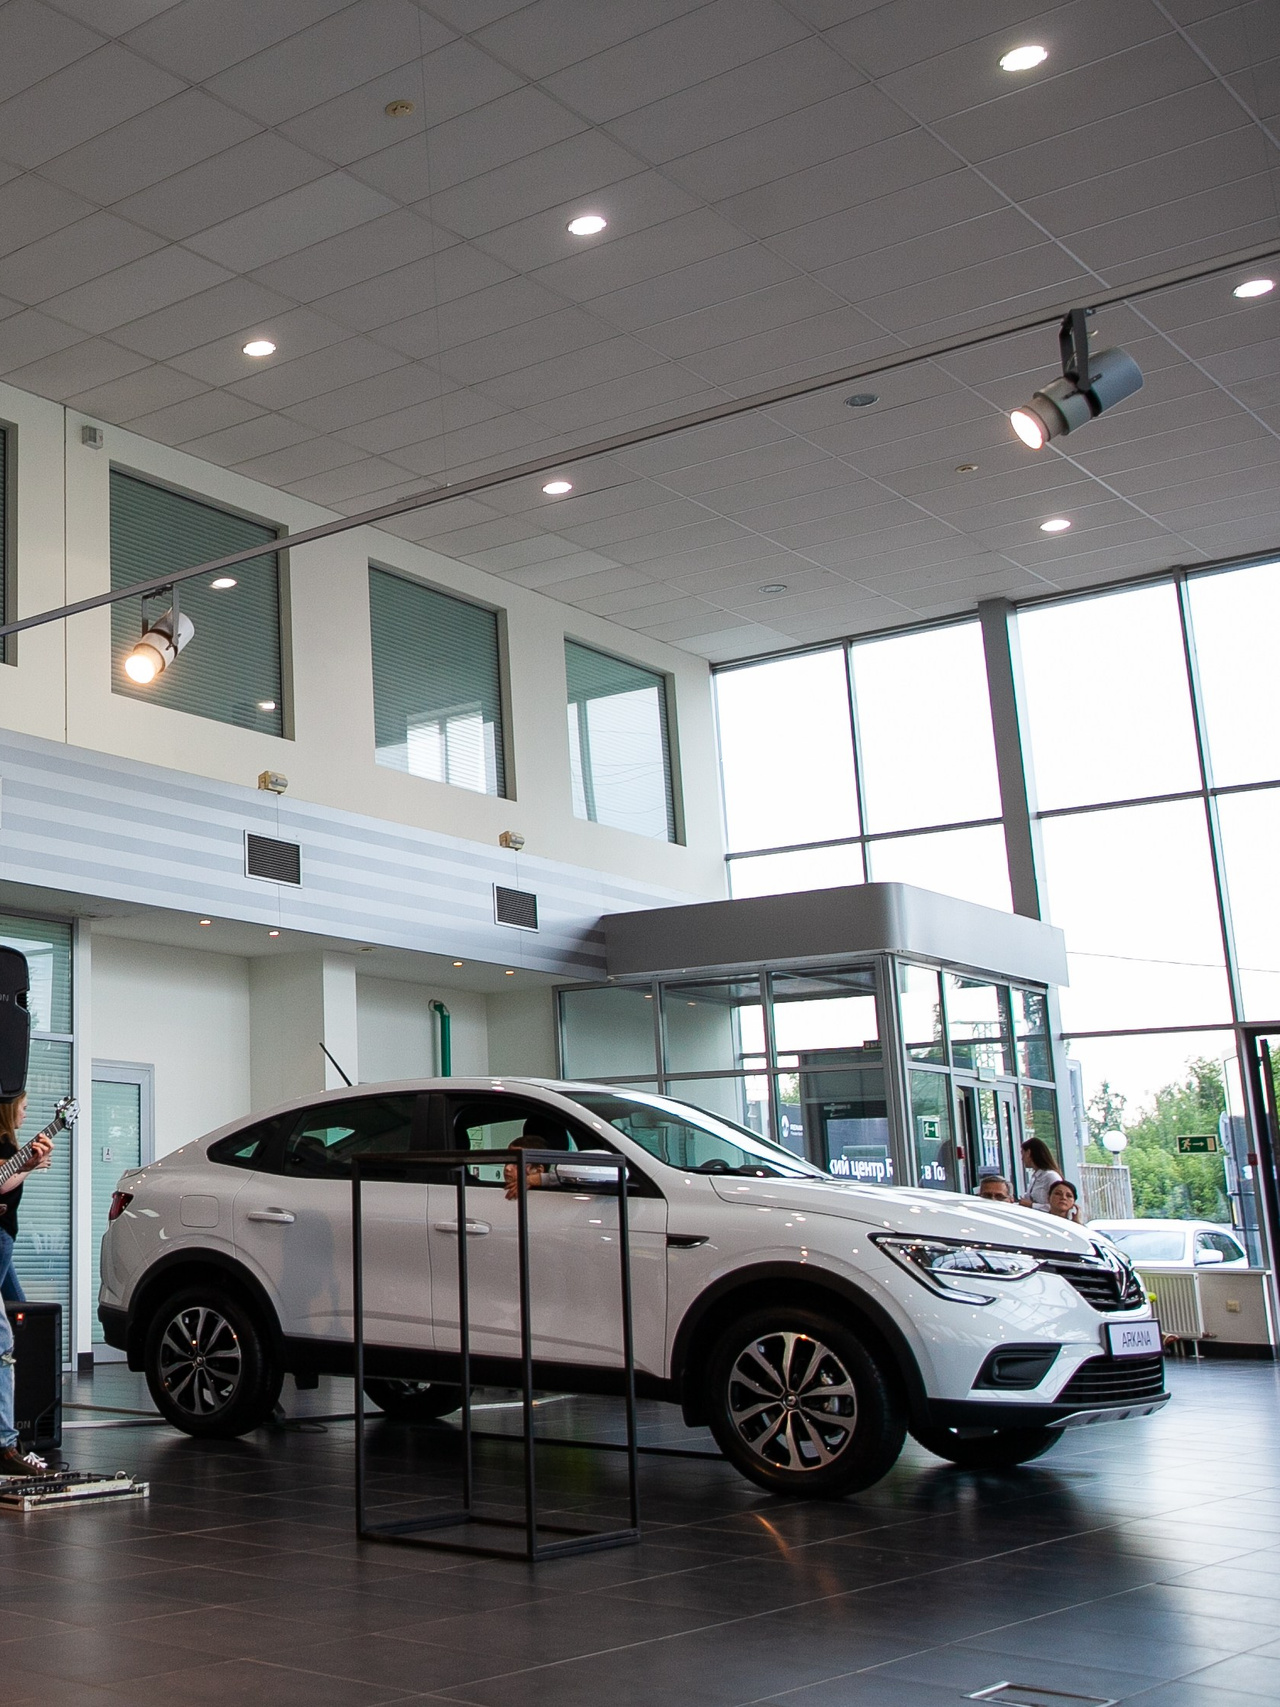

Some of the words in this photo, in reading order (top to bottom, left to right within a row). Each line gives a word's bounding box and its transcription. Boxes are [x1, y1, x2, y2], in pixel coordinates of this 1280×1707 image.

[850, 1161, 884, 1182] центр
[1122, 1331, 1152, 1348] ARKANA
[16, 1420, 31, 1429] ON
